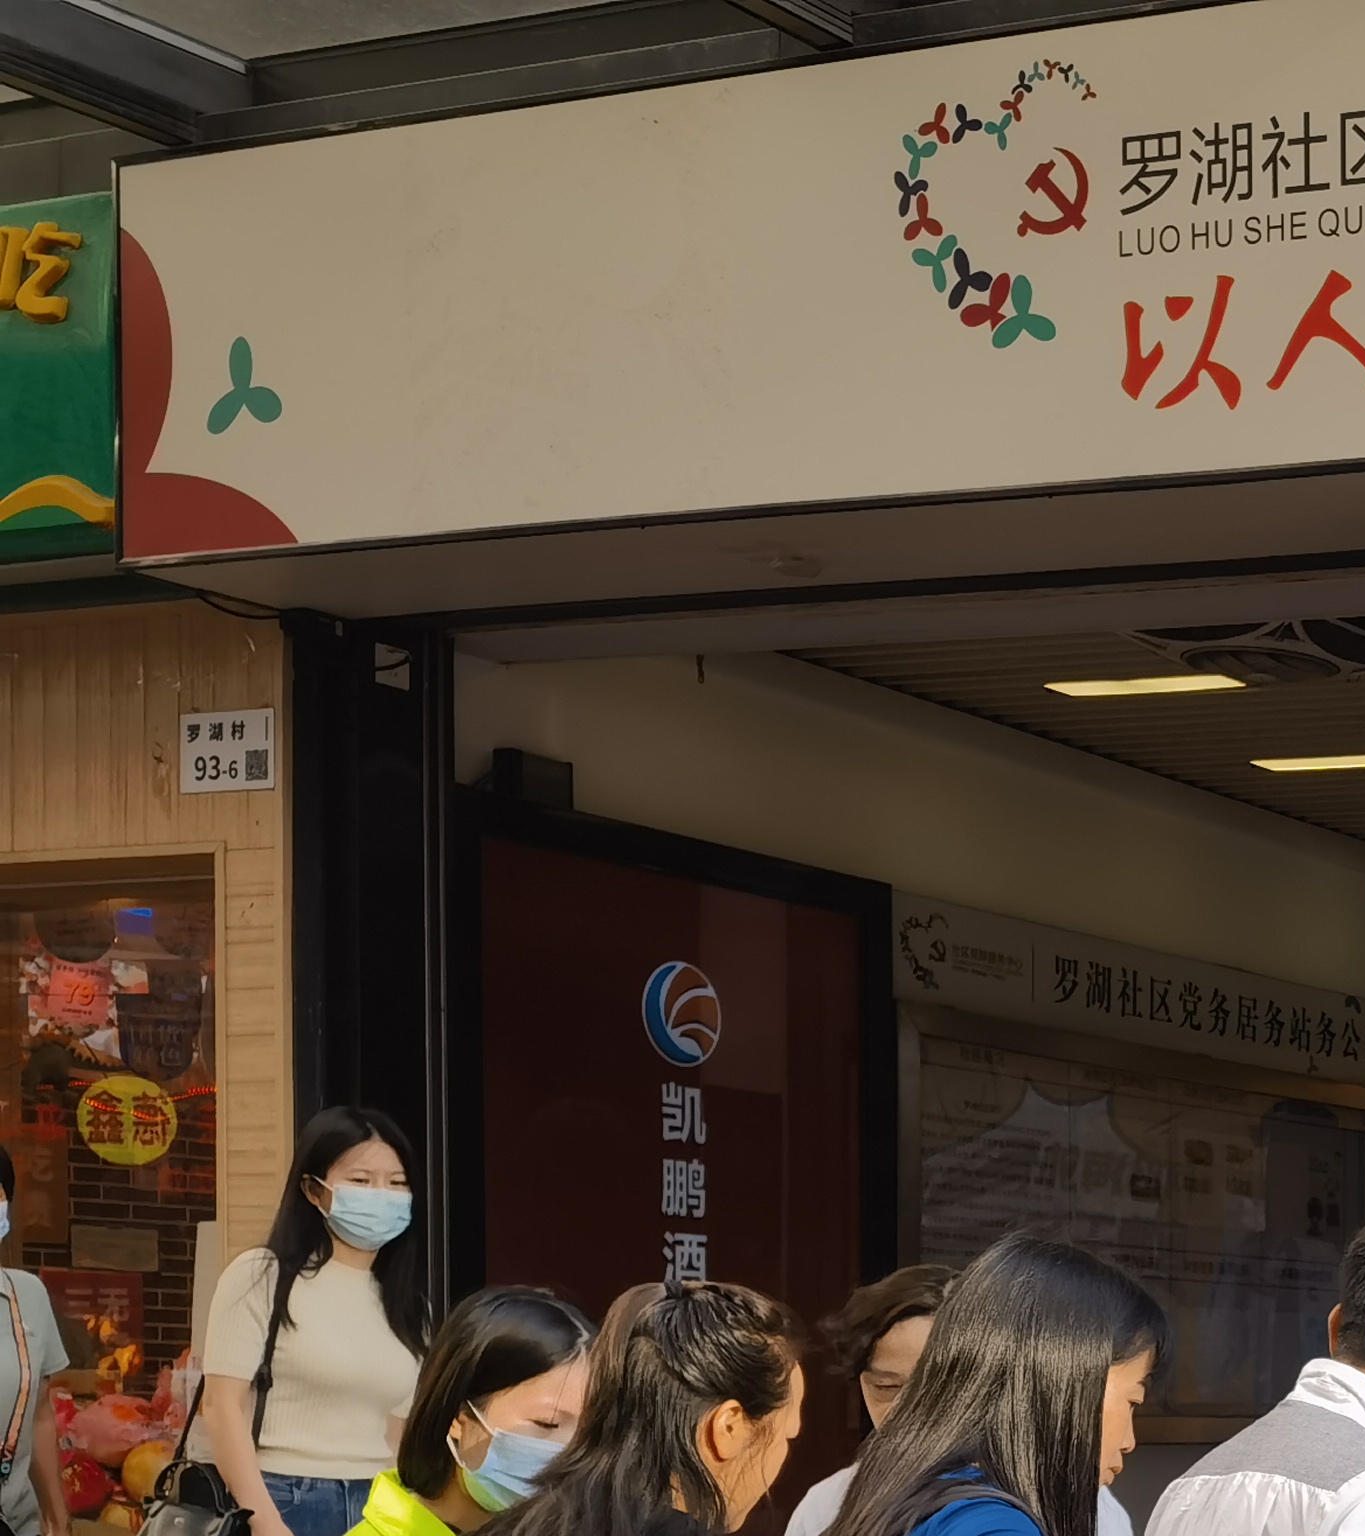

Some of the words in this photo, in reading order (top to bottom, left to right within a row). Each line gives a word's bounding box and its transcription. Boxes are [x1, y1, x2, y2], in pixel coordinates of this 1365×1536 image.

[1119, 224, 1181, 258] LUO
[1191, 218, 1233, 250] HU
[1244, 211, 1308, 245] SHE
[1318, 205, 1363, 237] QU
[187, 720, 245, 743] 罗湖村
[194, 755, 238, 781] 93-6
[661, 1081, 708, 1283] 凯鹏酒
